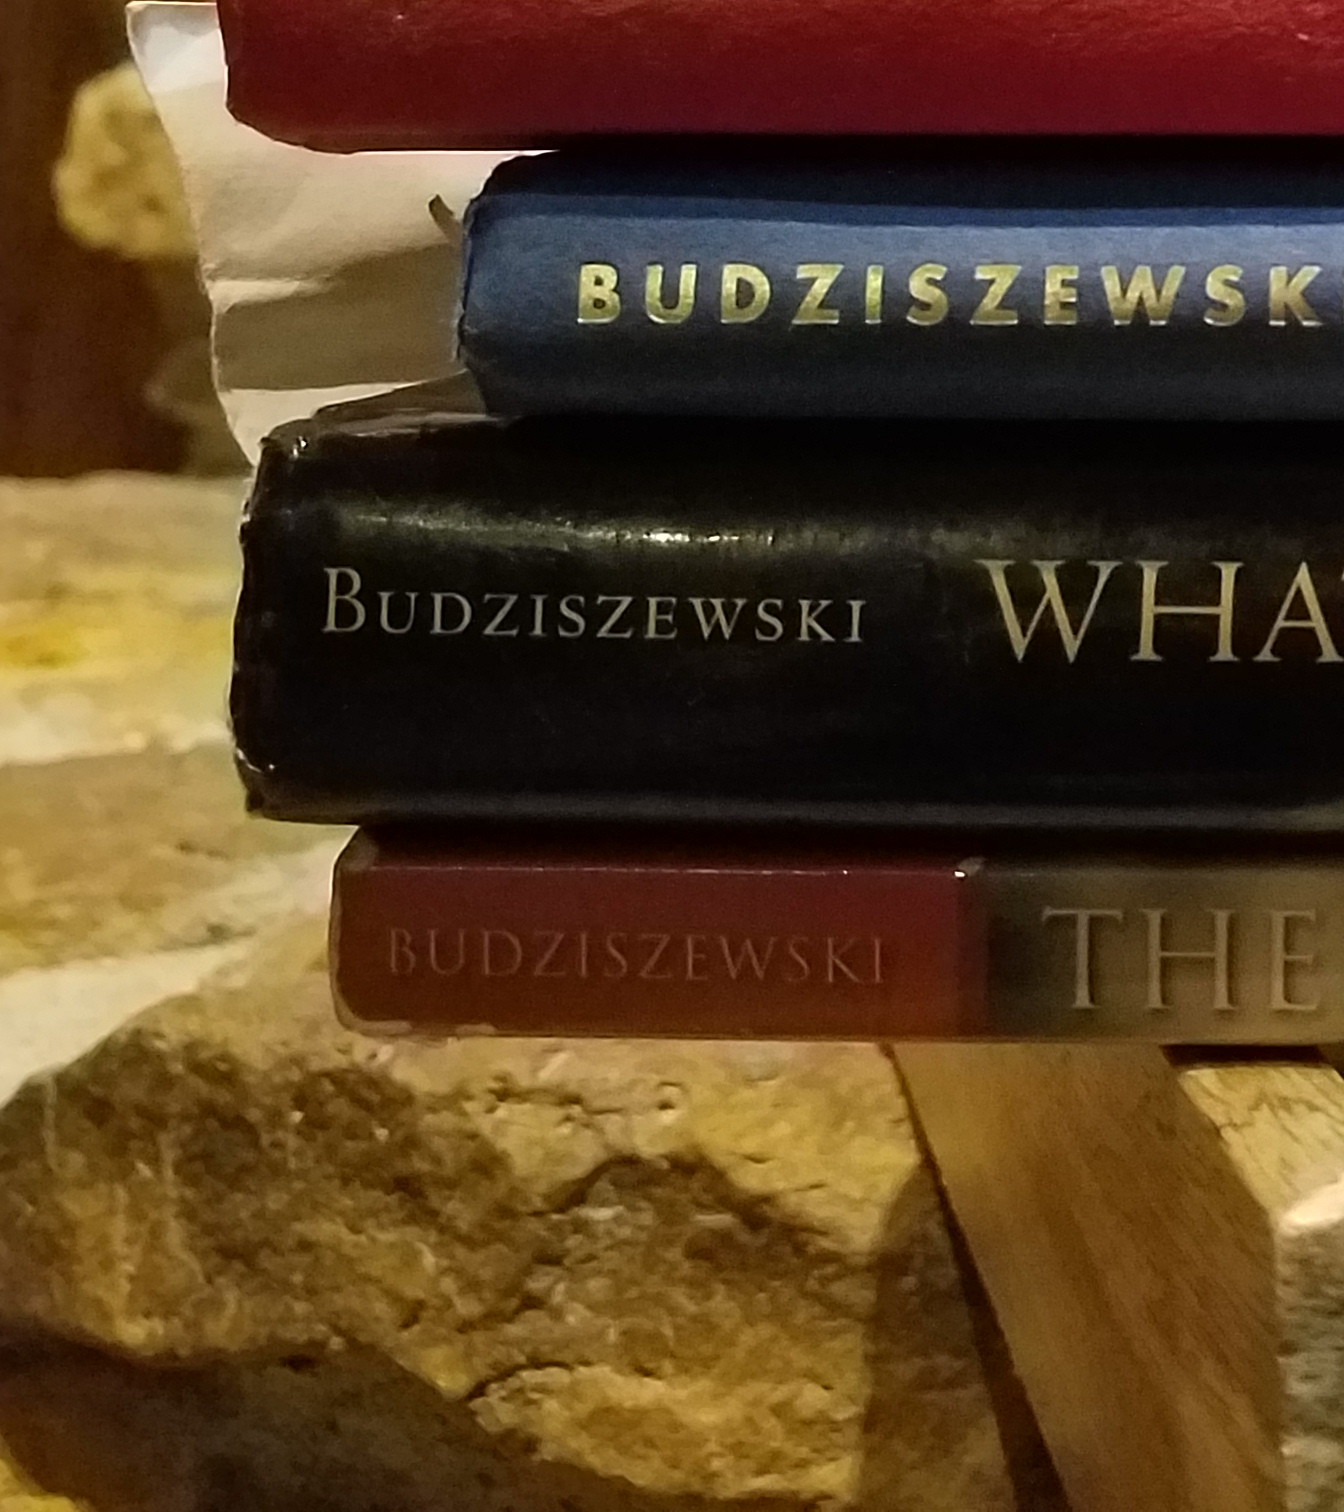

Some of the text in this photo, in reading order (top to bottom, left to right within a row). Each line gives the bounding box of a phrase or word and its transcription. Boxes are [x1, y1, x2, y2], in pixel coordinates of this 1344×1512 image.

[321, 566, 867, 646] BUDZISZEWSKI
[387, 926, 887, 986] BUDZISZEWSKI
[1042, 906, 1320, 1015] THE
